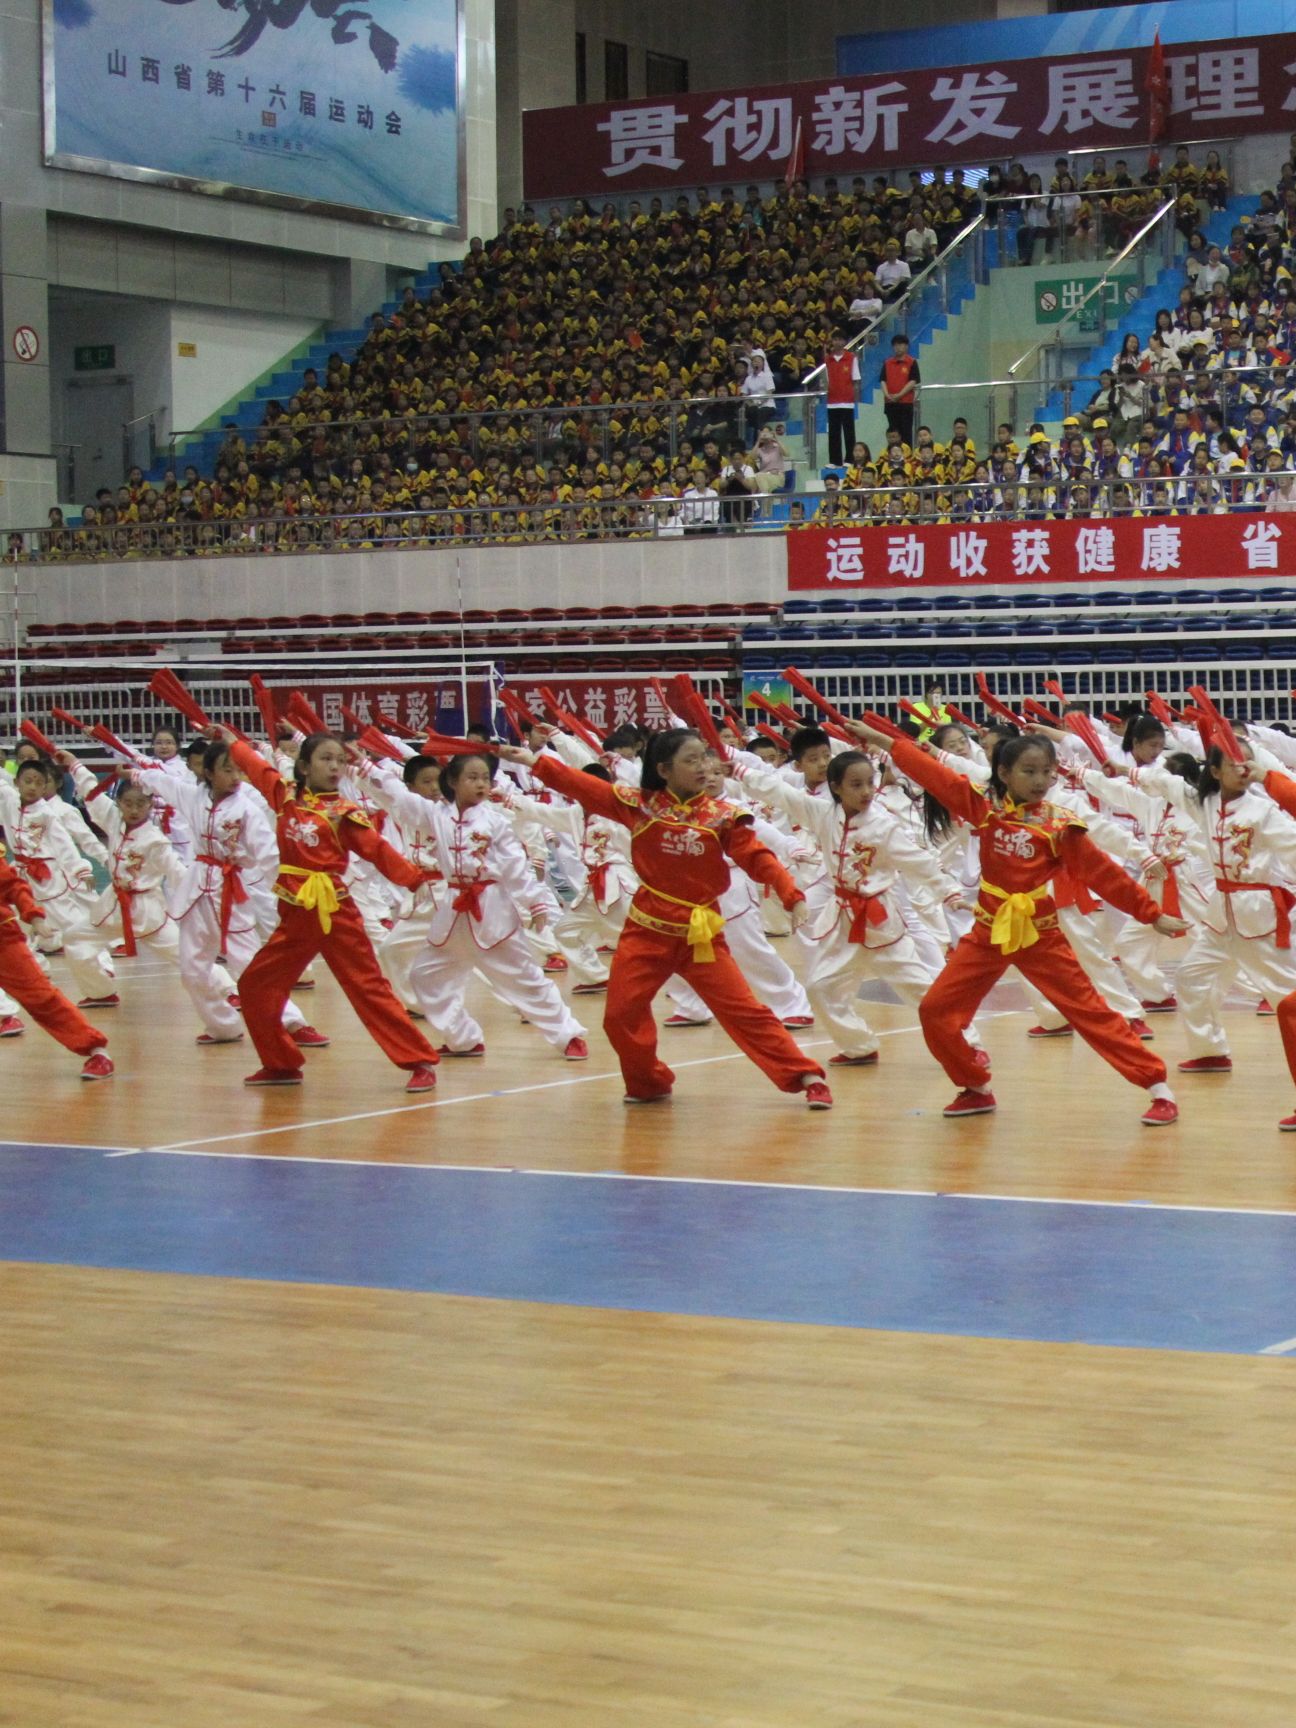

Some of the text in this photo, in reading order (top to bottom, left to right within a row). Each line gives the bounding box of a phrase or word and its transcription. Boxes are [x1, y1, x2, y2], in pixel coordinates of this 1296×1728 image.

[107, 48, 401, 136] 山西省第十六届运动会
[1062, 281, 1119, 309] 出口
[1076, 310, 1099, 319] EXI
[826, 524, 1182, 582] 运动收获健康
[761, 682, 771, 697] 4
